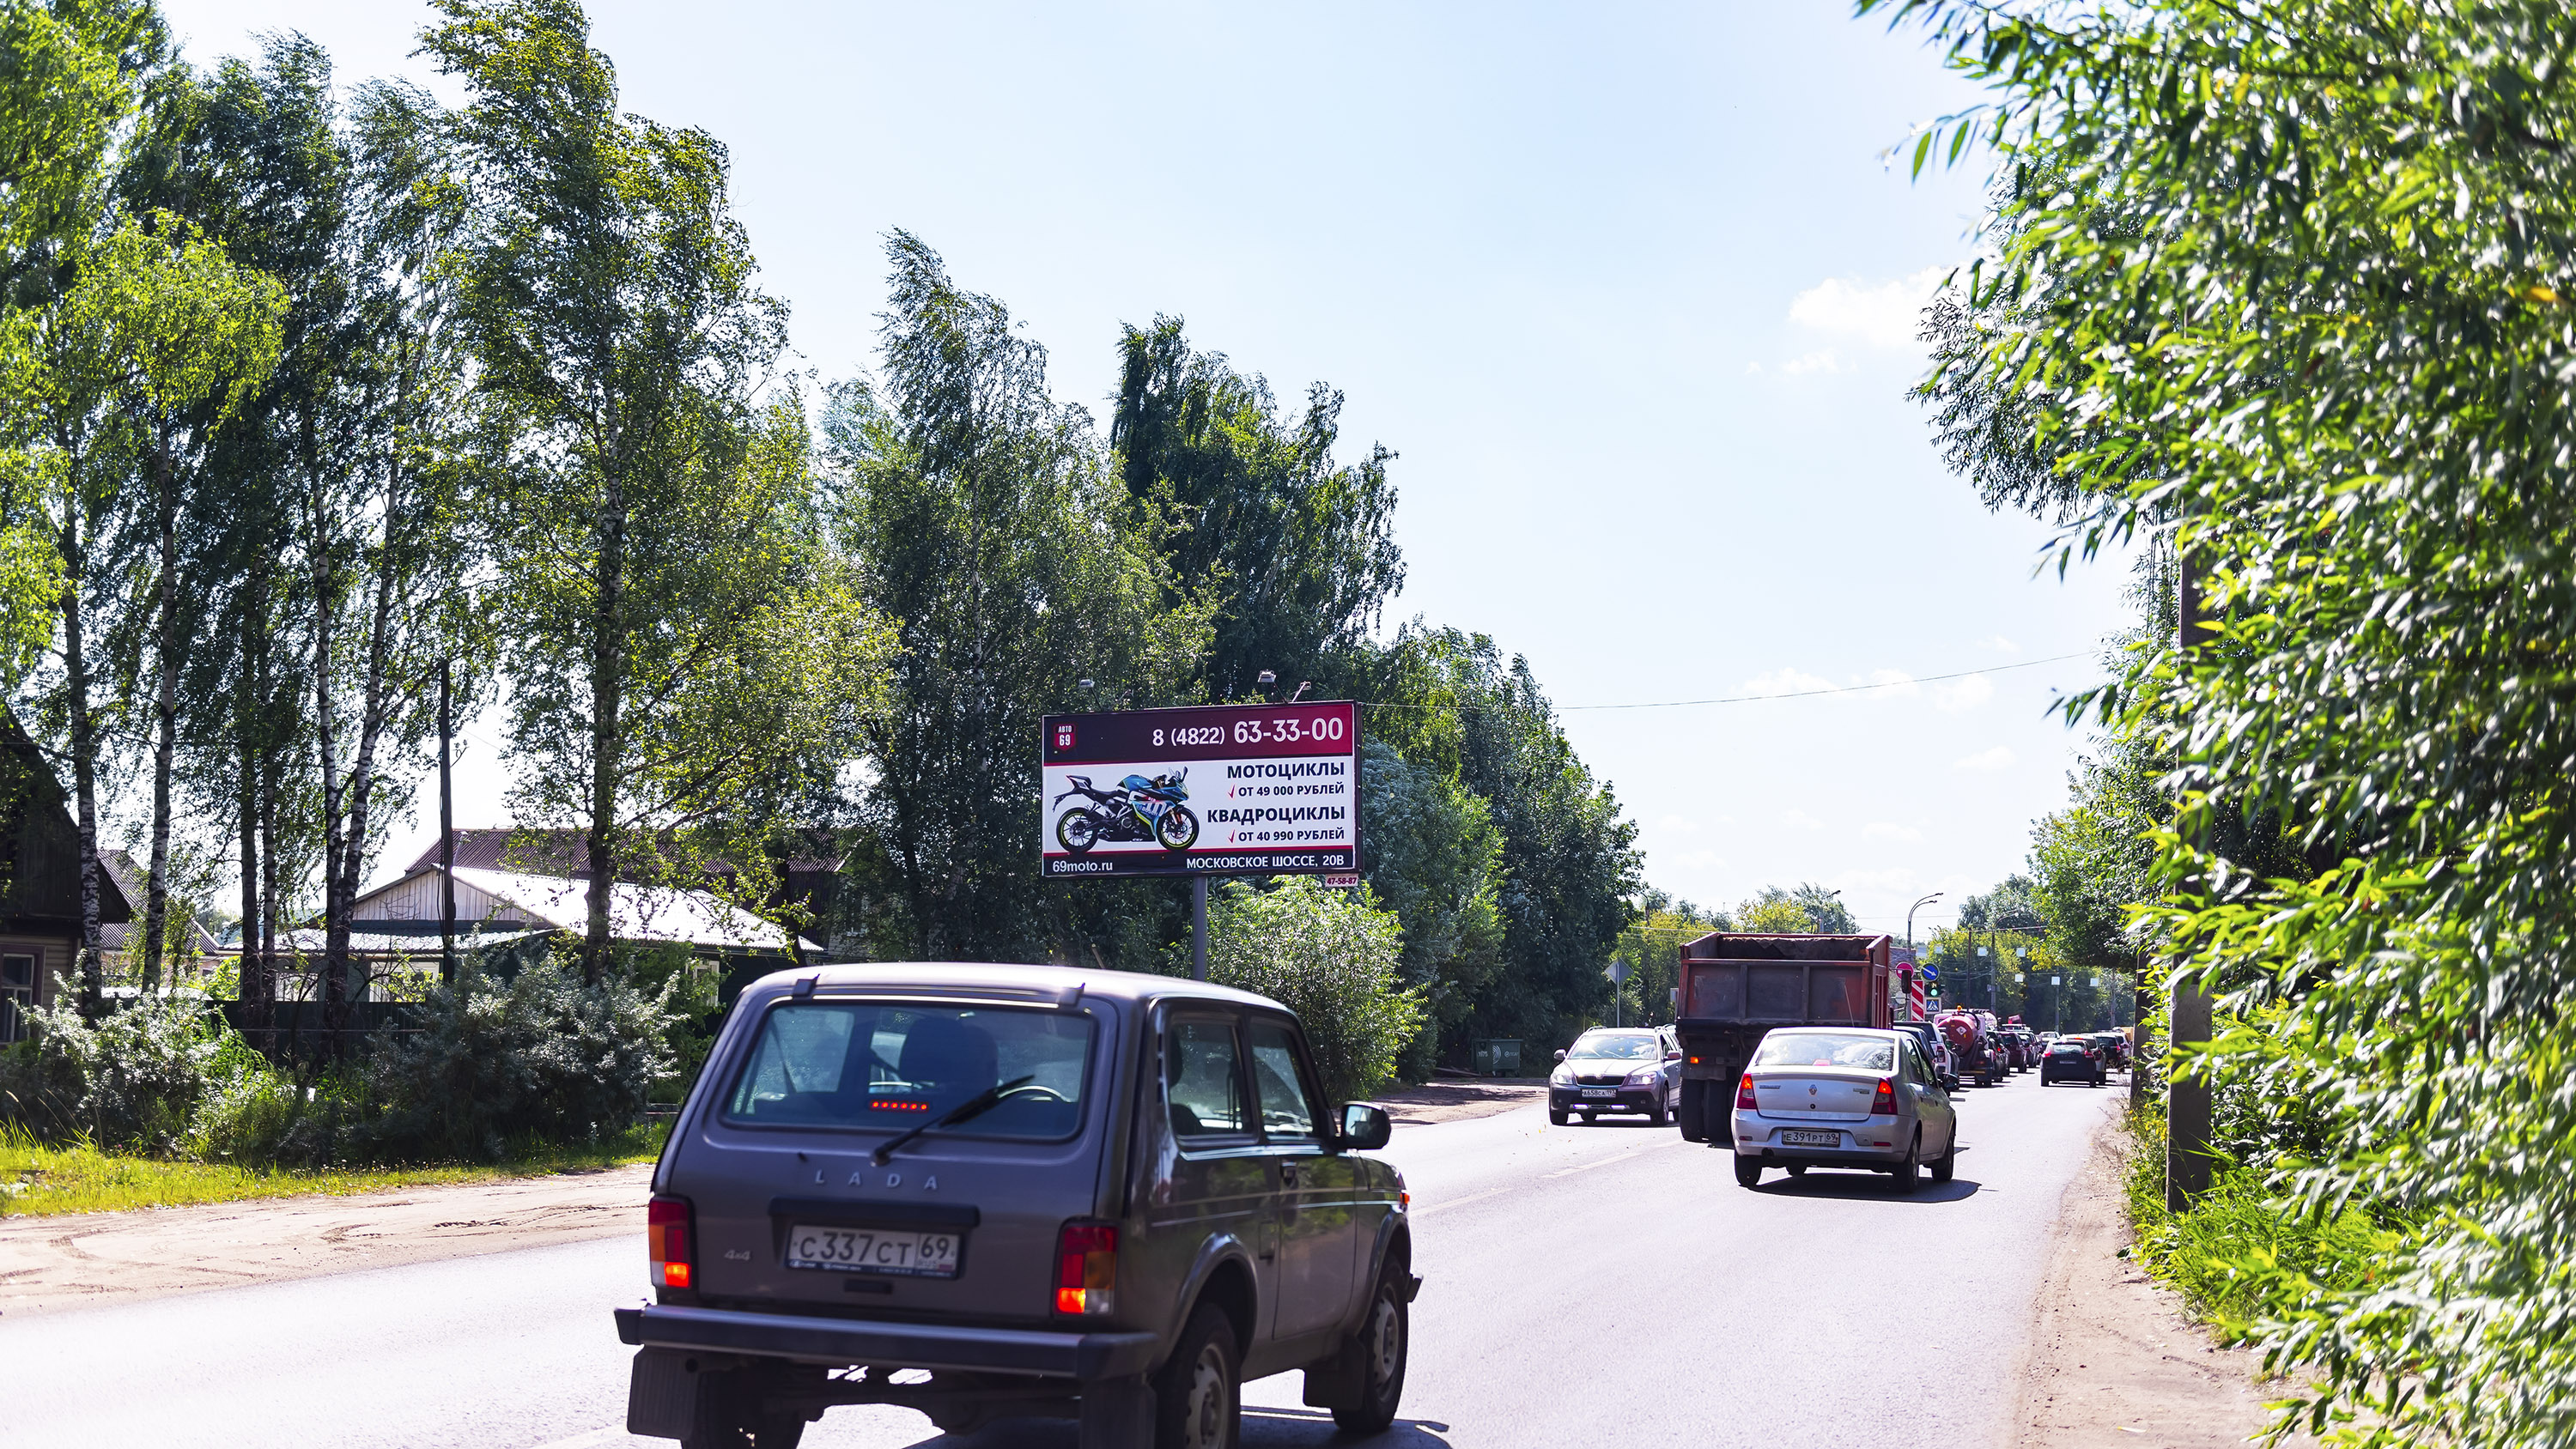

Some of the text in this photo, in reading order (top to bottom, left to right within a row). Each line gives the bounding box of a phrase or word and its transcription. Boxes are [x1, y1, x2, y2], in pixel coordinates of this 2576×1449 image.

[1152, 717, 1344, 746] 8 (4822) 63-33-00
[1059, 734, 1071, 746] 69
[1227, 762, 1345, 780] МОТОЦИКЛЫ
[1238, 781, 1345, 797] ОТ 49 000 РУБЛЕЙ
[1207, 806, 1346, 826] КВАДРОЦИКЛЫ
[1238, 827, 1345, 841] ОТ 40 990 РУБЛЕЙ
[1052, 860, 1113, 872] 69moto.ru
[1186, 854, 1344, 869] МОСКОВСКОЕ ШОССЕ, 20В
[1327, 876, 1358, 885] 47-58-87
[815, 1169, 938, 1190] LADA
[799, 1231, 950, 1264] С337СТ 69
